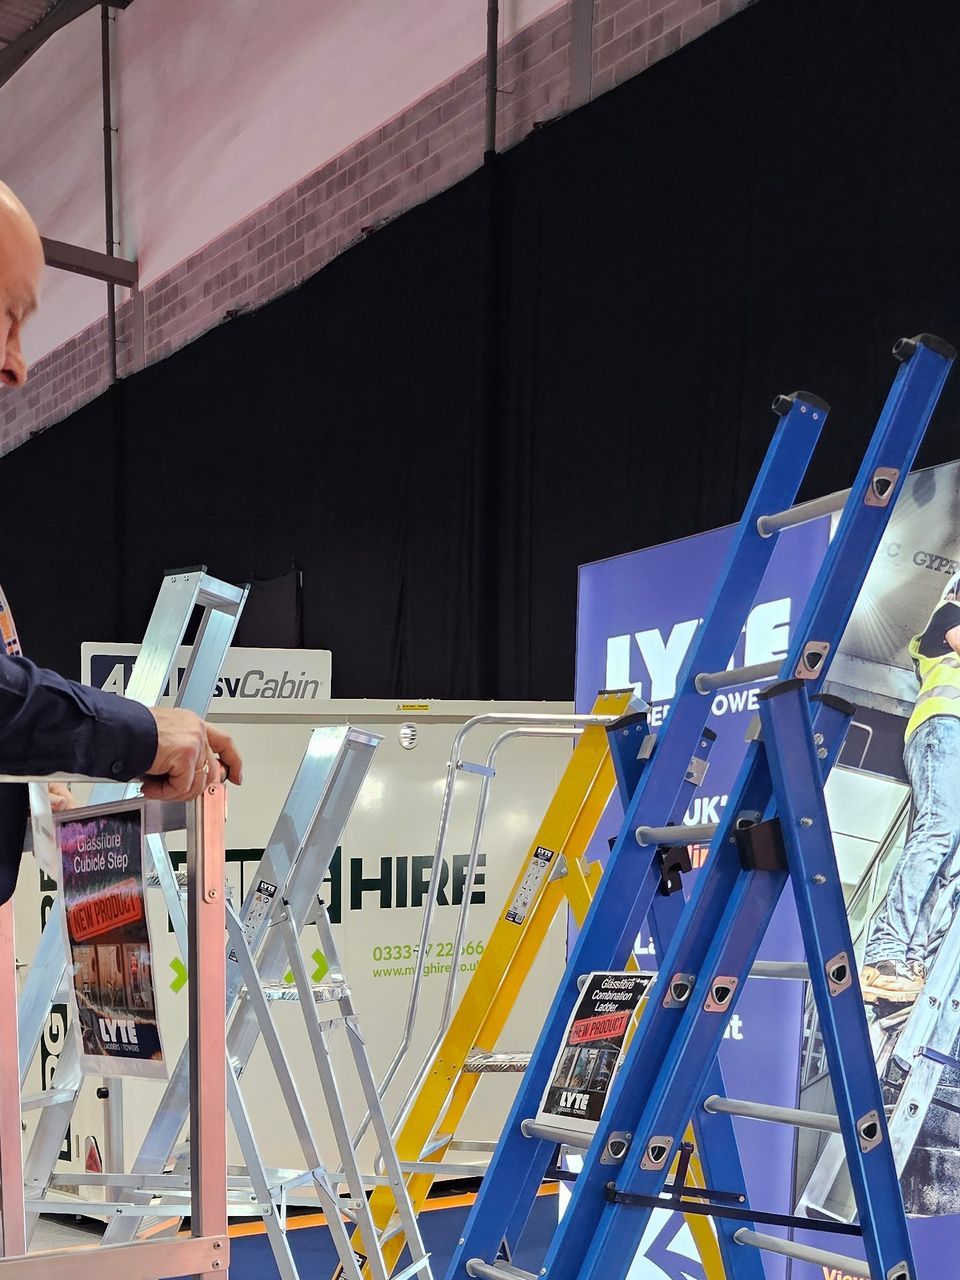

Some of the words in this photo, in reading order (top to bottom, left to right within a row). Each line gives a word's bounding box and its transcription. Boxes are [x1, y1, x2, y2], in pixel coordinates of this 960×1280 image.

[912, 550, 960, 576] GYPR
[605, 597, 790, 702] LYE
[74, 853, 105, 873] Cubicle
[108, 851, 128, 872] Step
[350, 853, 487, 911] HIRE
[73, 902, 93, 934] NEW
[94, 892, 136, 926] PRODUCT
[373, 944, 412, 961] 0333
[436, 942, 453, 957] 22
[592, 990, 633, 1001] Combination
[595, 1001, 619, 1012] Ladder
[99, 1018, 138, 1044] LYTE
[590, 1016, 625, 1036] PRODUCT
[560, 1091, 589, 1110] LYTE
